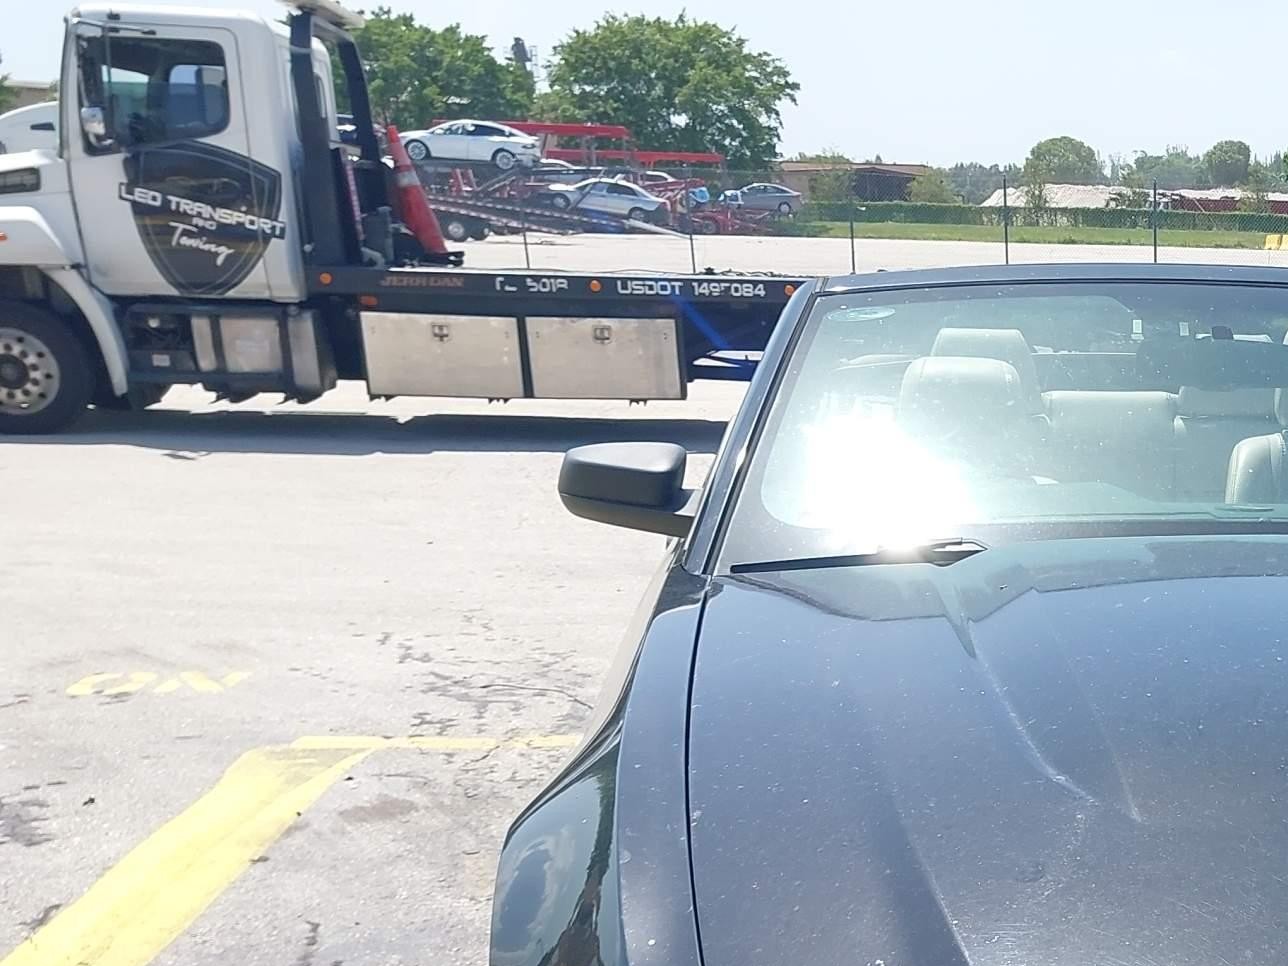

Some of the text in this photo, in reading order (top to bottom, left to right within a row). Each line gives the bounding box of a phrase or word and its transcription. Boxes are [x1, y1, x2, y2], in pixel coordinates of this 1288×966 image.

[120, 184, 286, 236] LED TRANSPORT
[616, 280, 684, 296] USDOT
